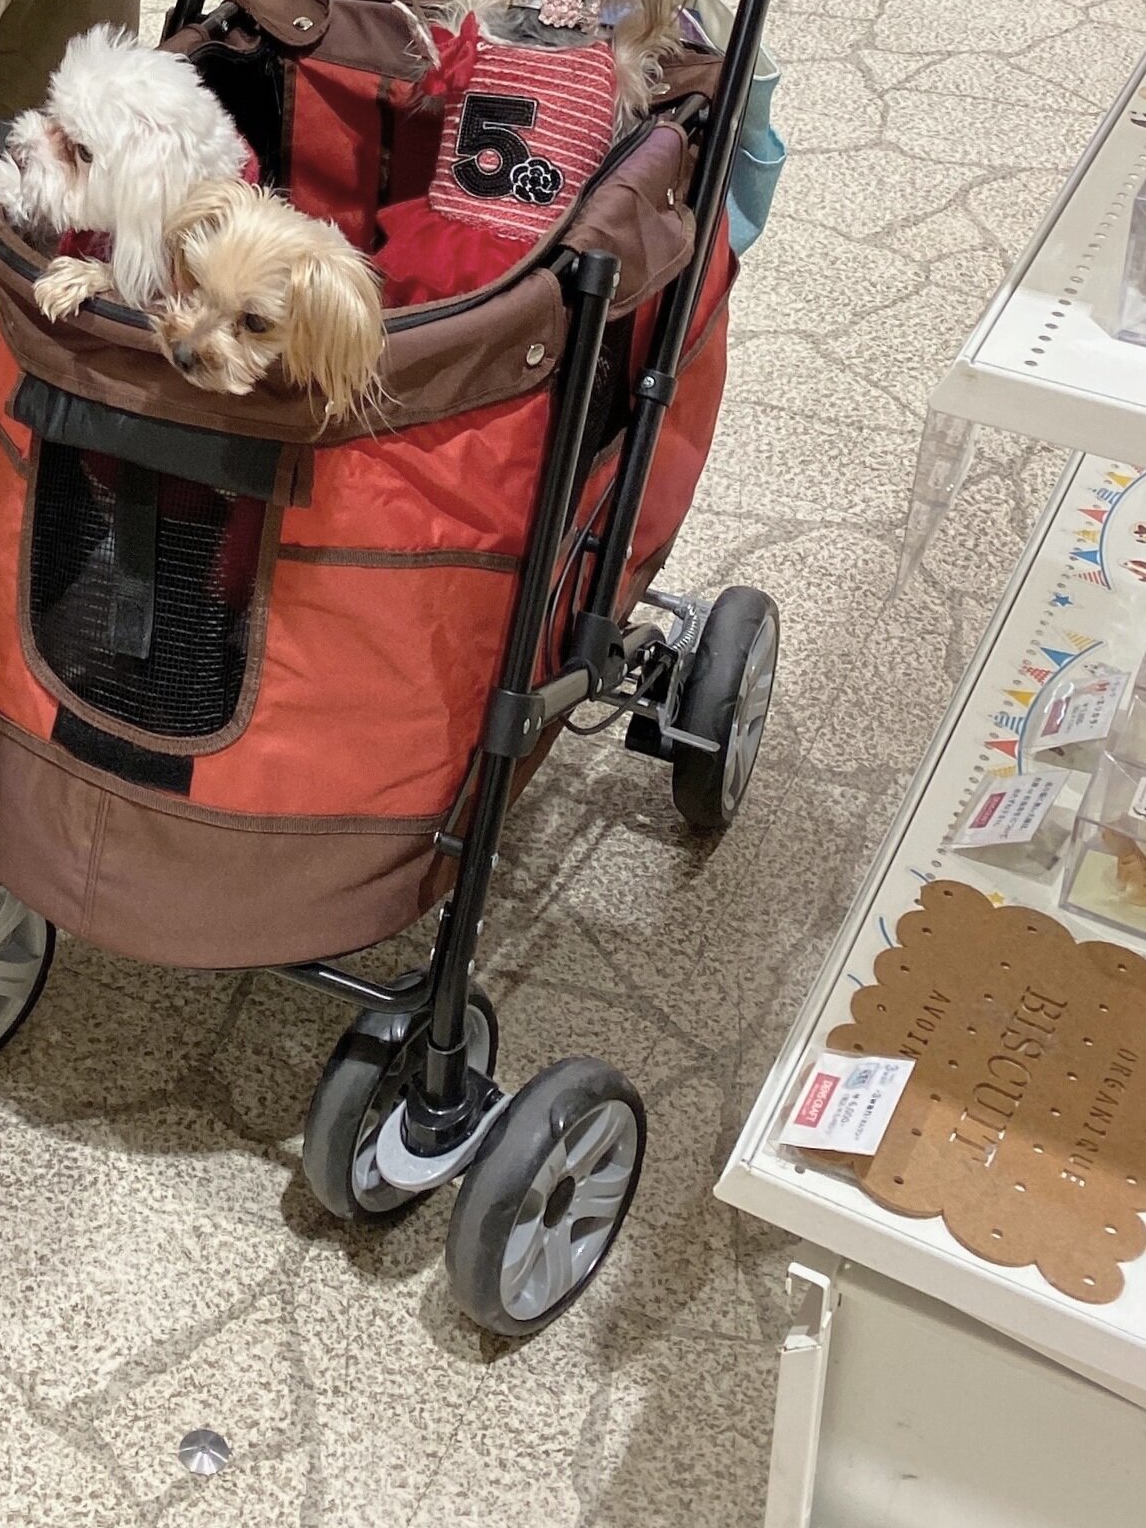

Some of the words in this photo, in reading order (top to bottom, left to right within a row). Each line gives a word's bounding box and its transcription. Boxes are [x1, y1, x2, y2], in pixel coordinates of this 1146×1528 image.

[452, 93, 539, 199] 5
[948, 985, 1068, 1170] BISCUIT
[1059, 1047, 1140, 1189] ORGANIQUE
